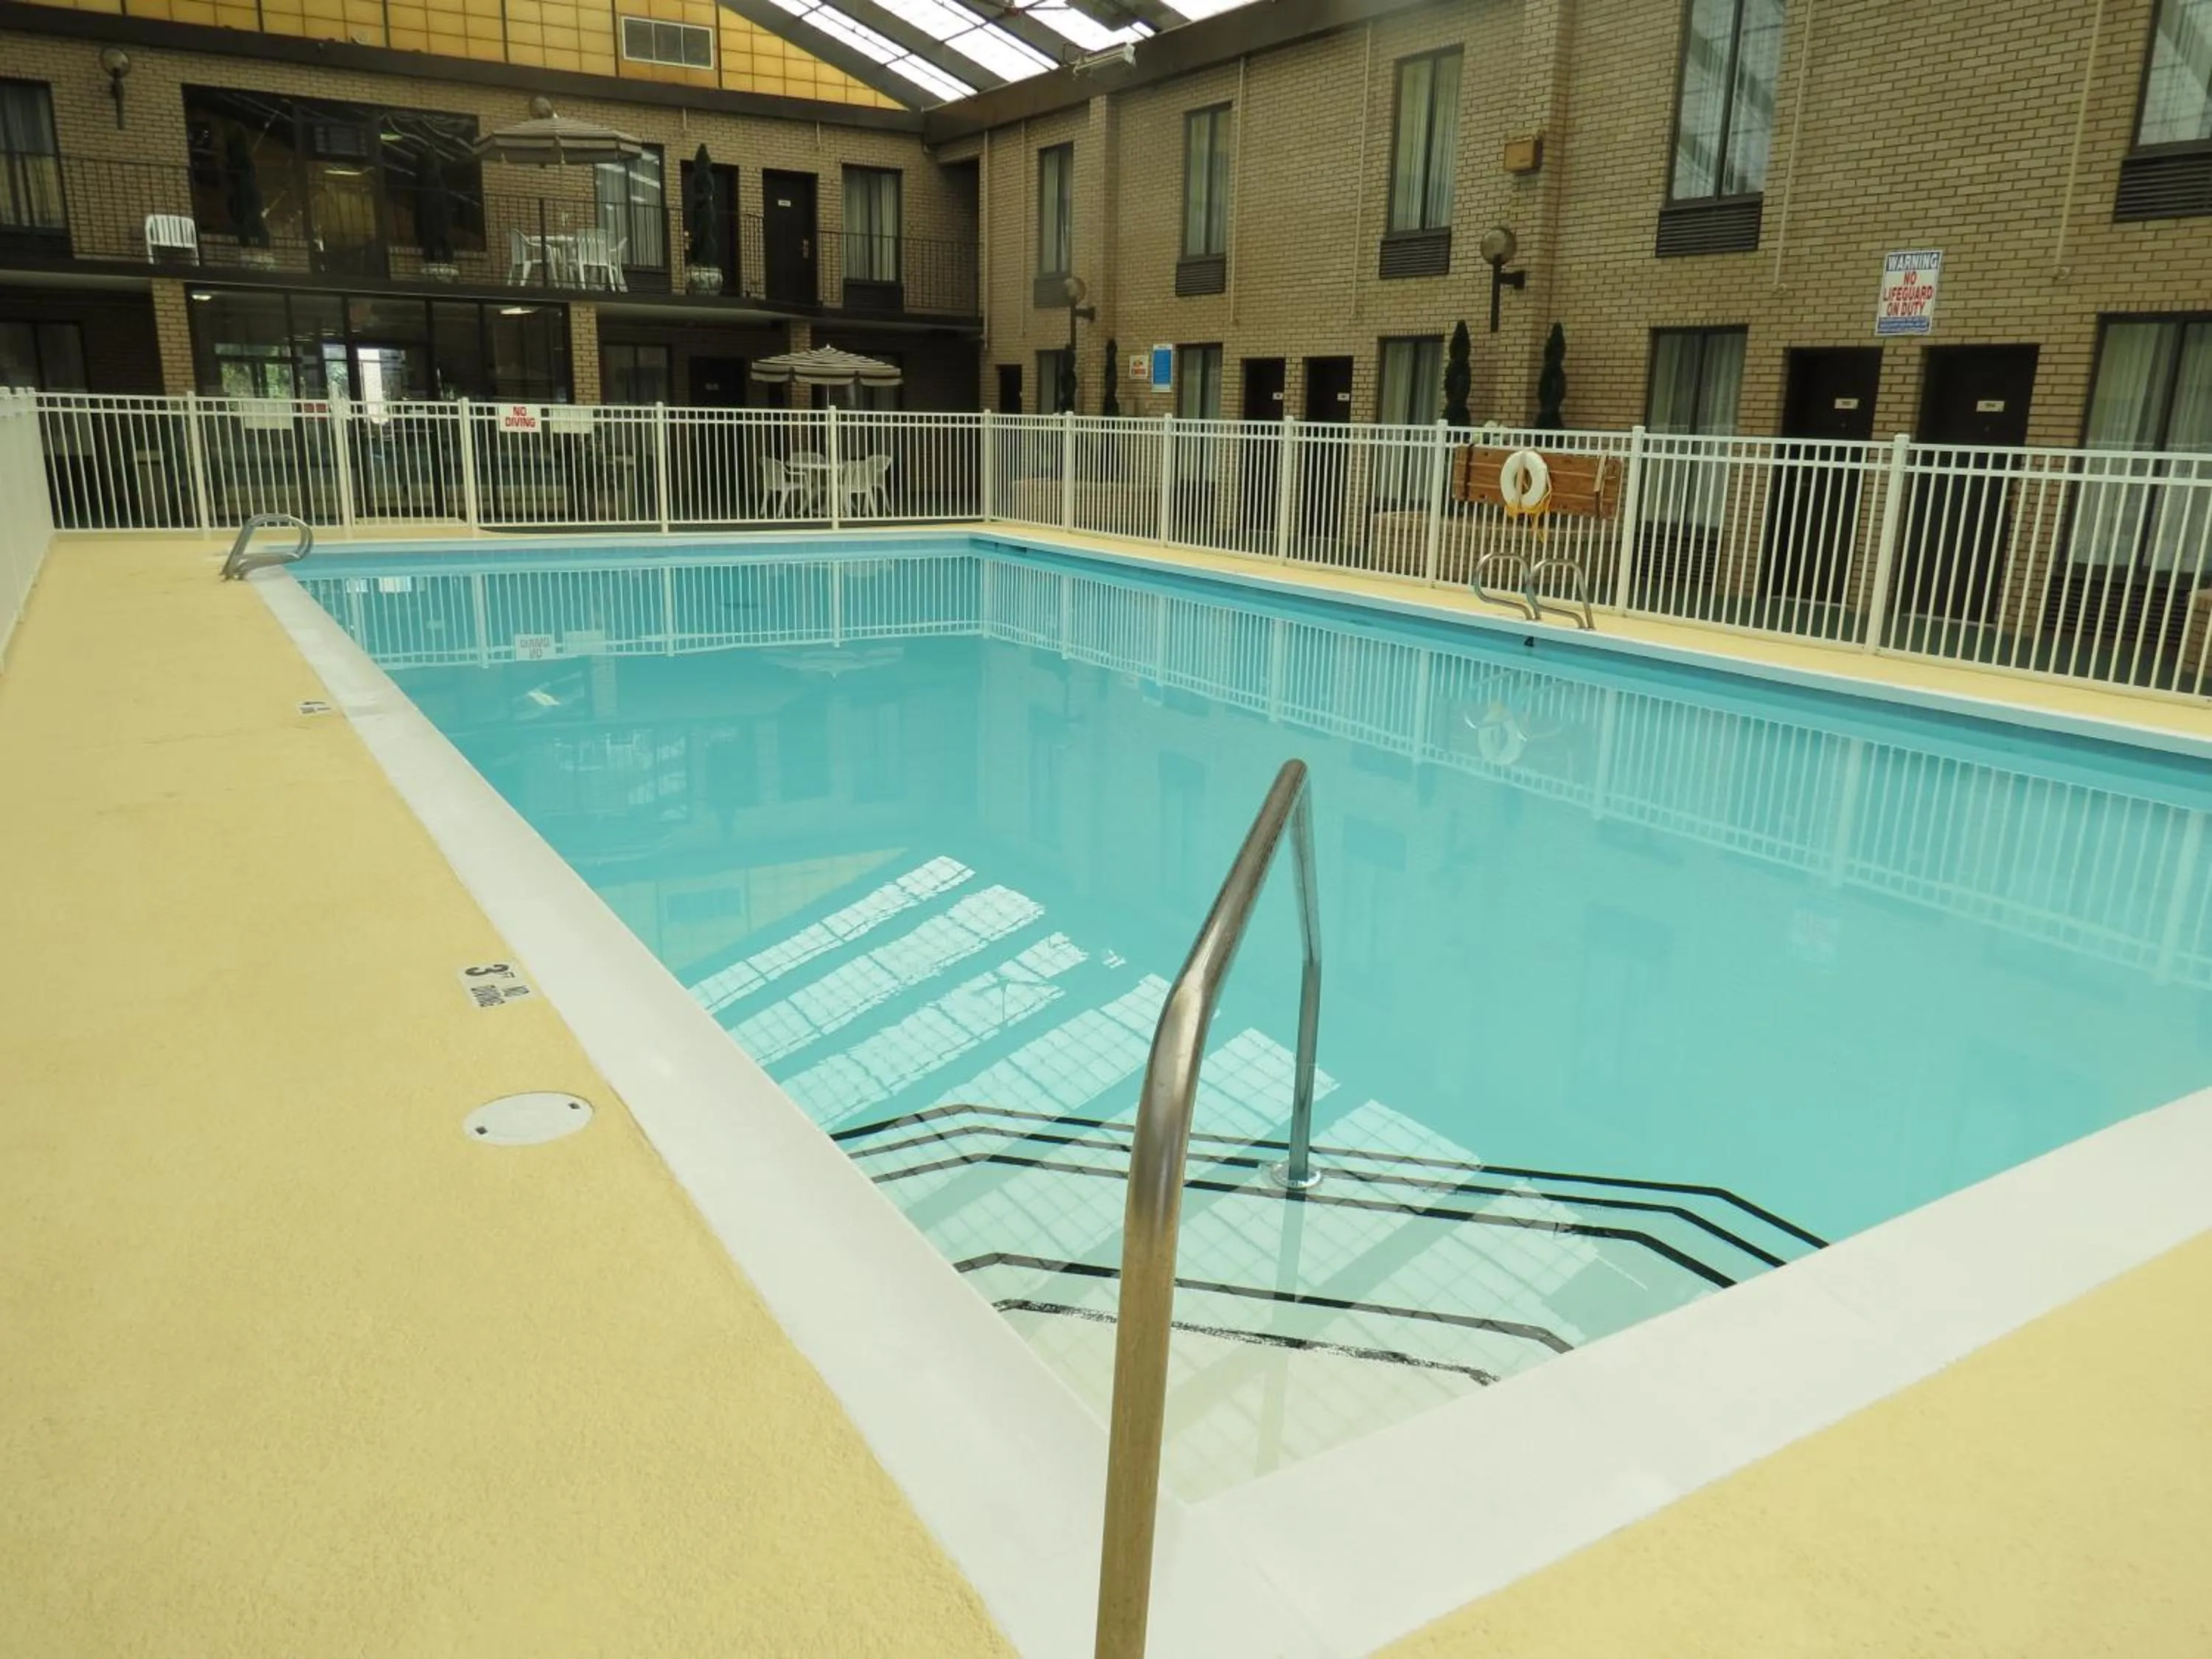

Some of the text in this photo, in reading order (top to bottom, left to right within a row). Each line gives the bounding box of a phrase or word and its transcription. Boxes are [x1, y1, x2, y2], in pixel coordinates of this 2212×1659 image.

[1888, 253, 1938, 271] WARNING
[1904, 271, 1917, 285] NO
[1883, 285, 1933, 302] LIFEGUARD
[1887, 300, 1925, 316] ON DUTY
[512, 406, 526, 417] NO
[505, 417, 536, 428] DIVING
[465, 964, 509, 976] 3
